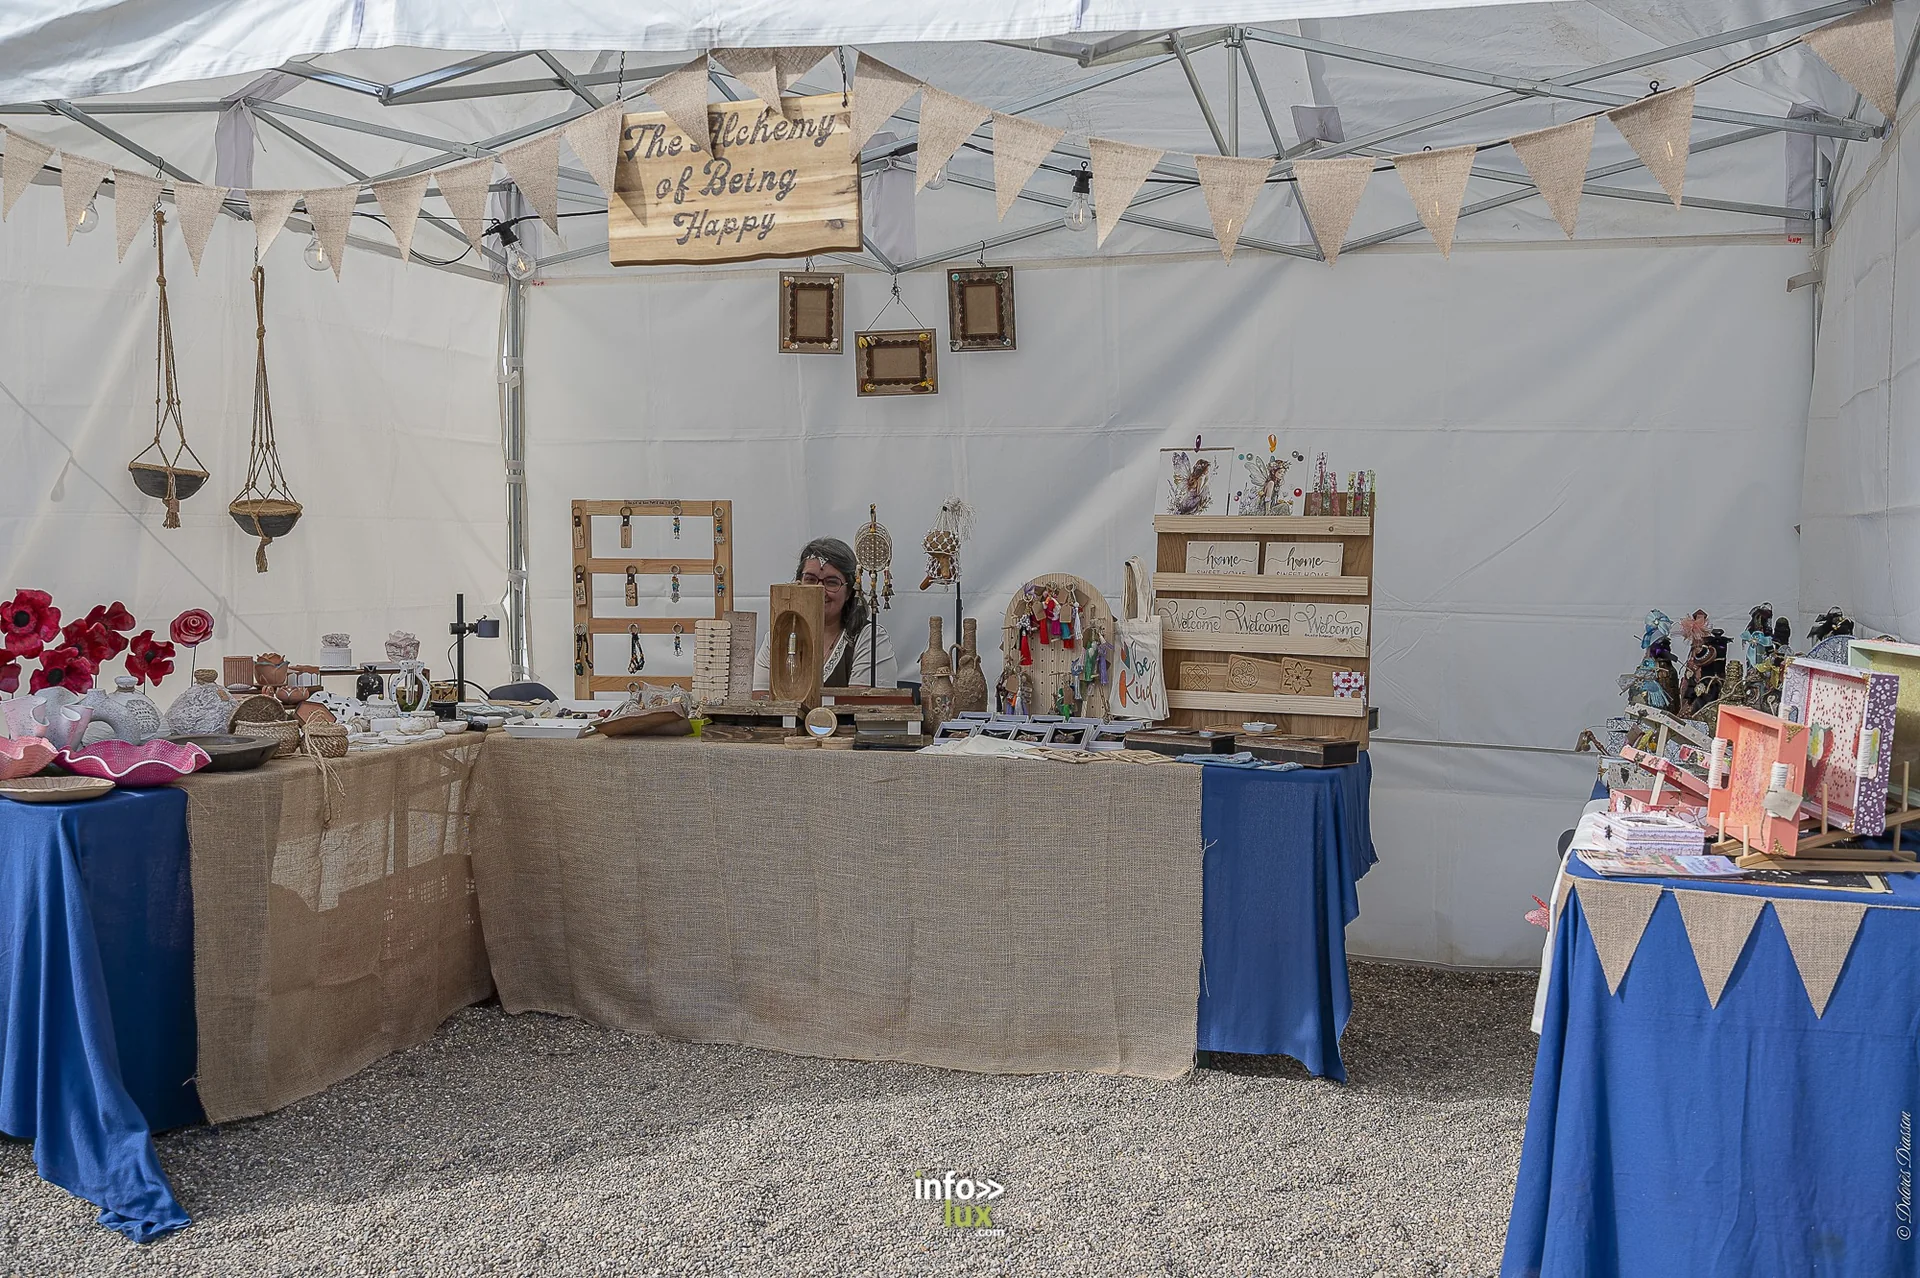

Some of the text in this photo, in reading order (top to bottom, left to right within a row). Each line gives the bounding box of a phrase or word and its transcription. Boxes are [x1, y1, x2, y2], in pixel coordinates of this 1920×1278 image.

[623, 110, 836, 162] The Alchemy
[656, 156, 797, 204] of Being
[672, 208, 776, 246] Happy
[1158, 600, 1221, 633] Welcome
[1224, 602, 1291, 636] Welcome
[1294, 603, 1363, 640] Welcome
[1130, 640, 1152, 678] be
